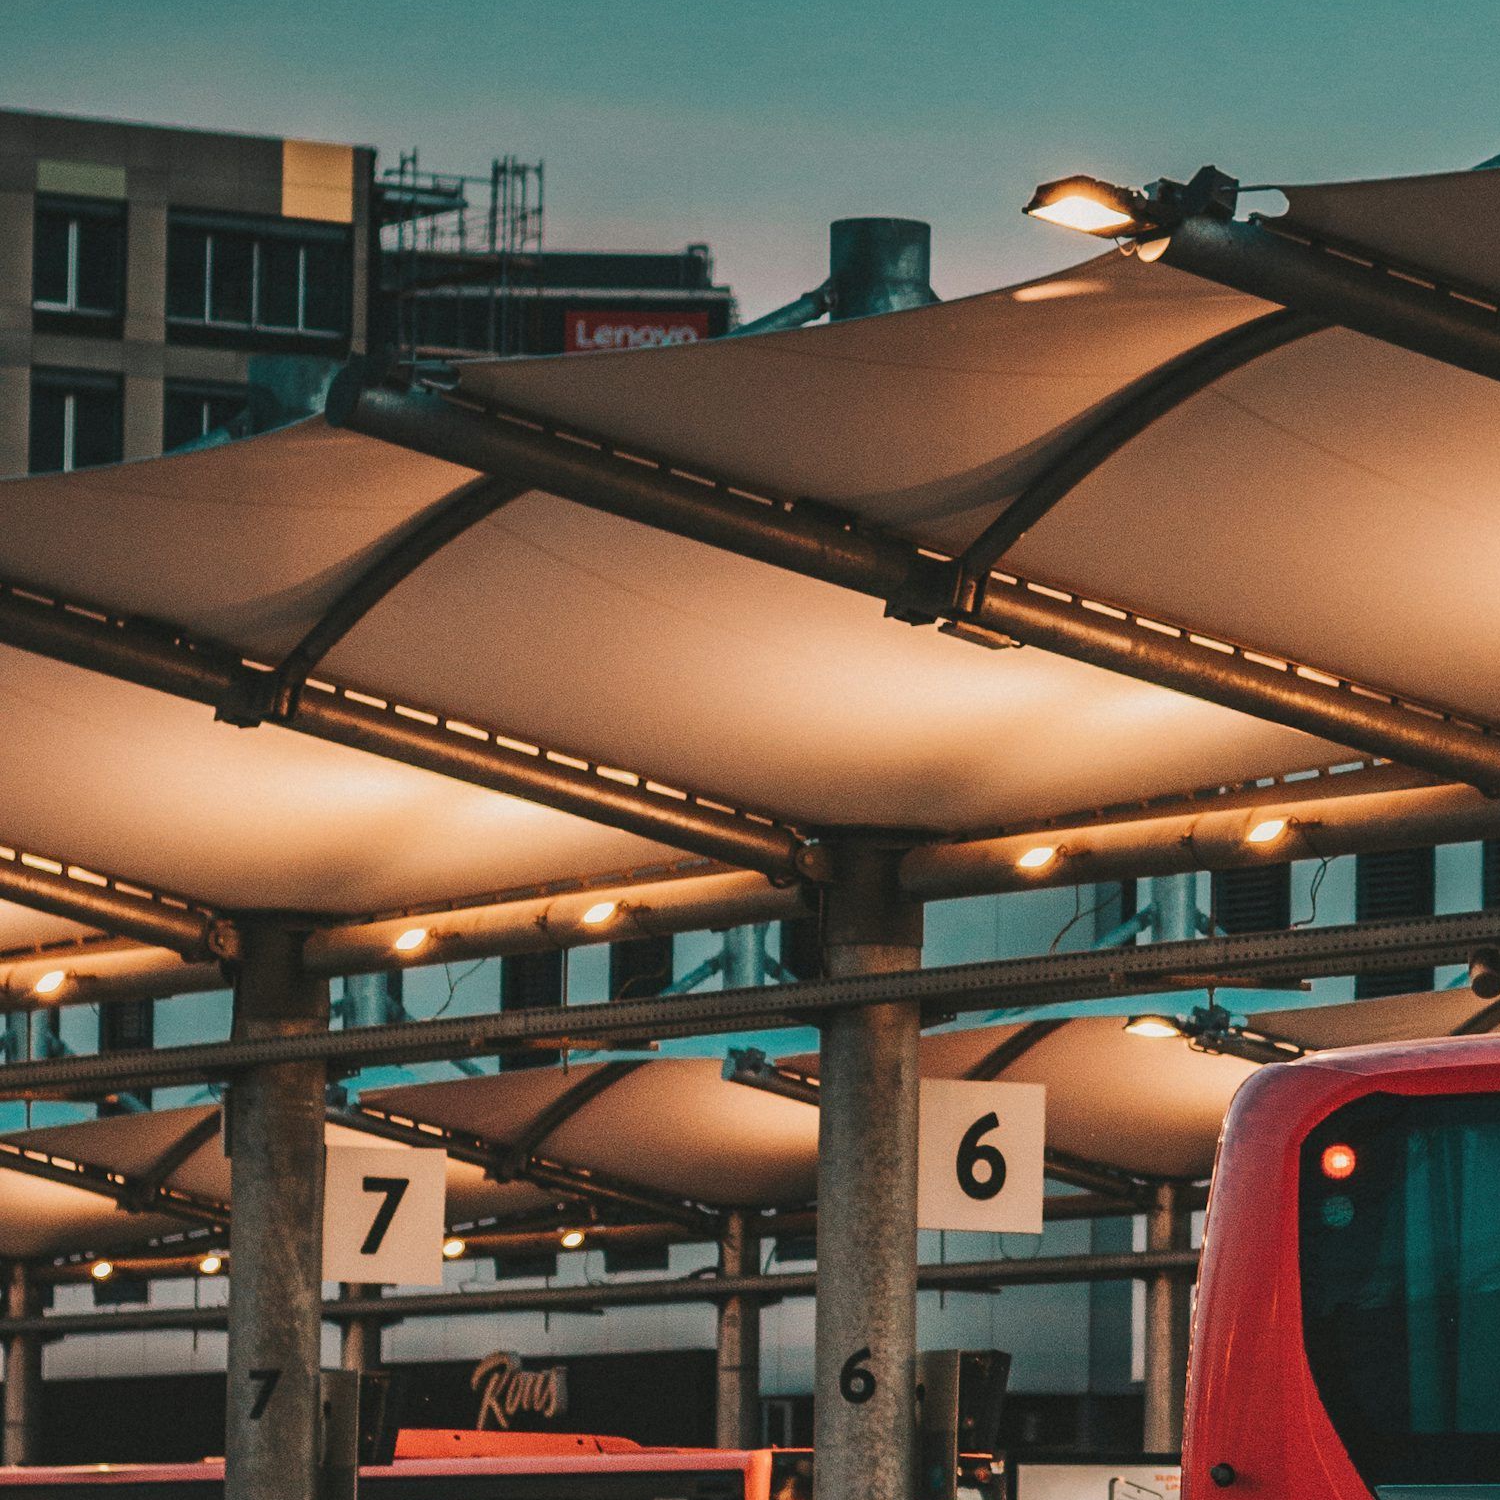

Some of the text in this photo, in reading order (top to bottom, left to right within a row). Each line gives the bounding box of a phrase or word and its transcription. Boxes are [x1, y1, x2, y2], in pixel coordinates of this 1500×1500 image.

[576, 320, 698, 349] Lenovo
[956, 1111, 1006, 1200] 6
[360, 1176, 409, 1254] 7
[249, 1369, 281, 1419] 7
[840, 1346, 876, 1405] 6
